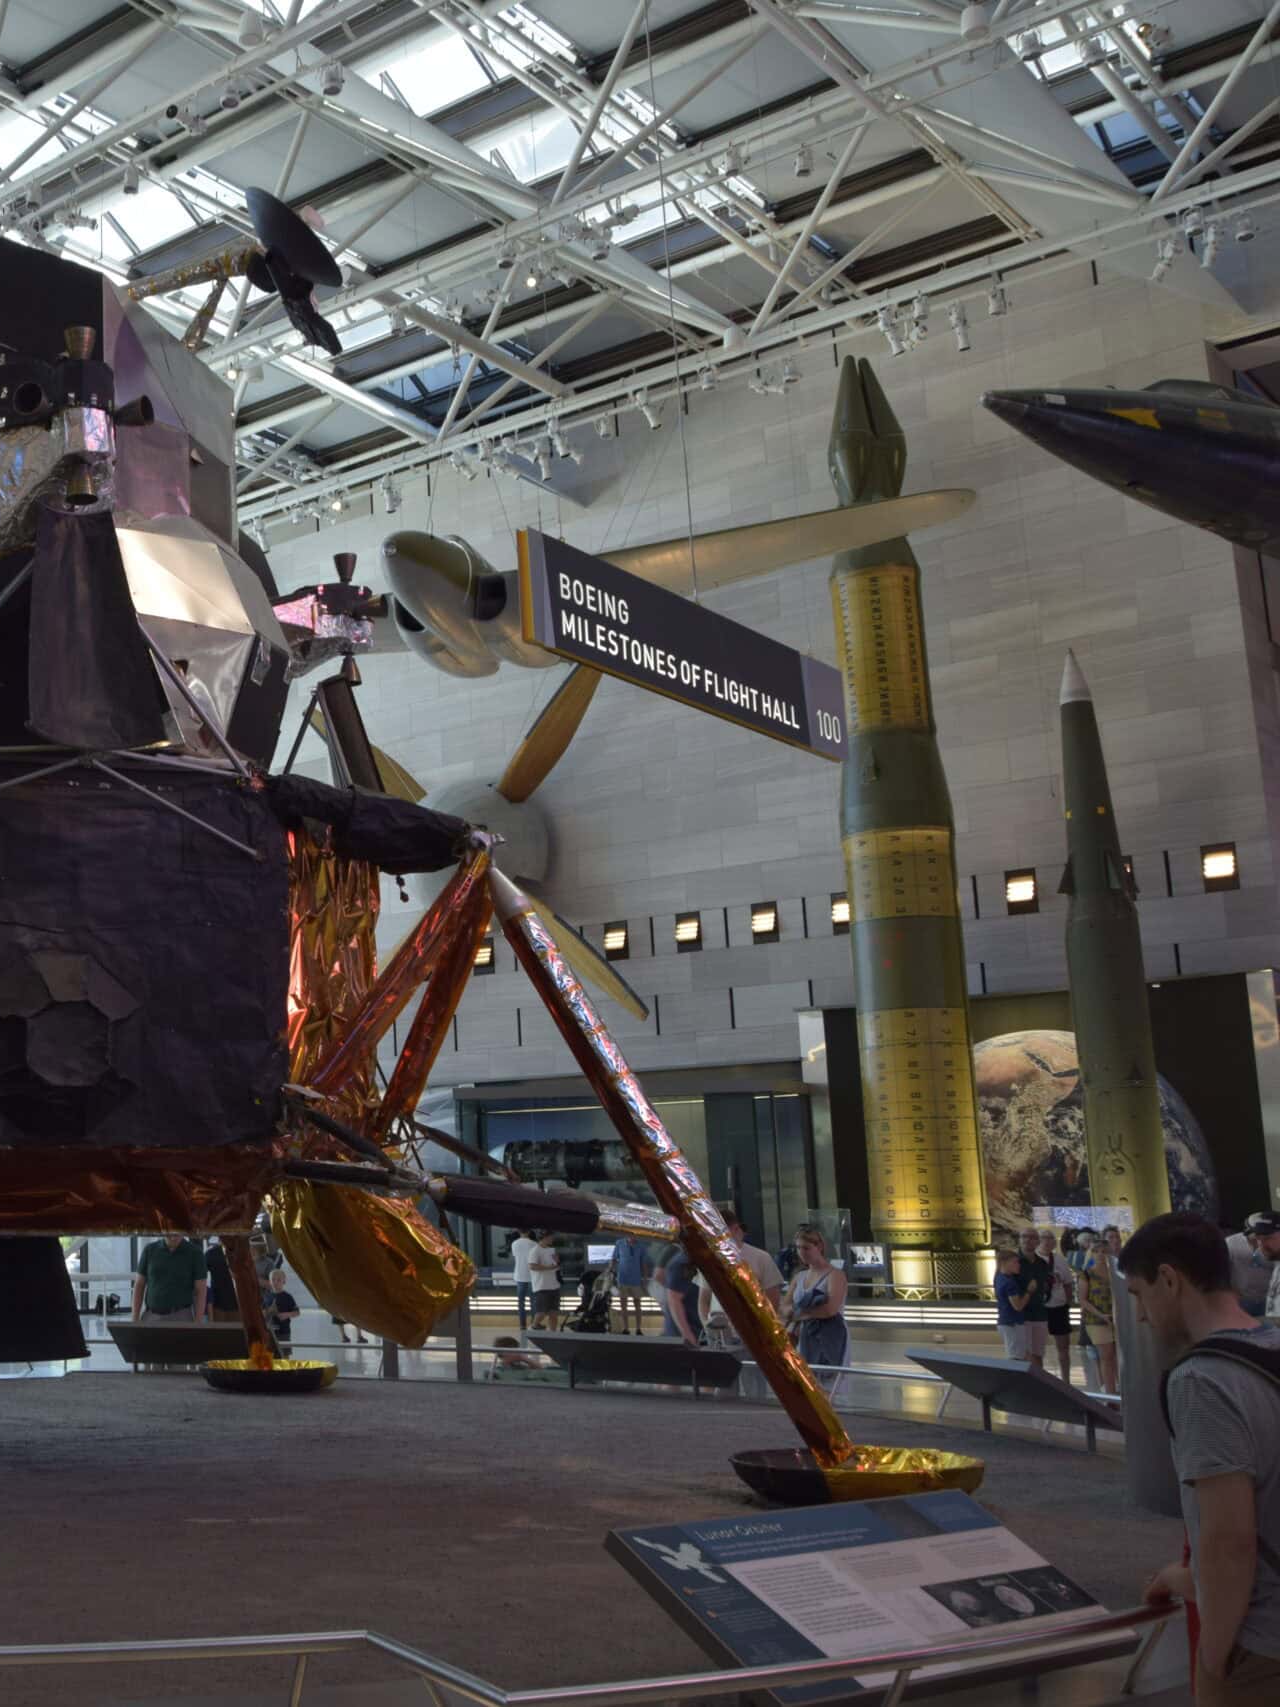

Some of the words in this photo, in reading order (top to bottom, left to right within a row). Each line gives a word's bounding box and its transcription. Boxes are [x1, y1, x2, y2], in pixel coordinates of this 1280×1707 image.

[559, 573, 629, 624] BOEING
[561, 610, 677, 680] MILESTONES
[680, 660, 701, 688] OF
[704, 670, 758, 713] FLIGHT
[761, 696, 801, 730] HALL
[816, 709, 842, 744] 100
